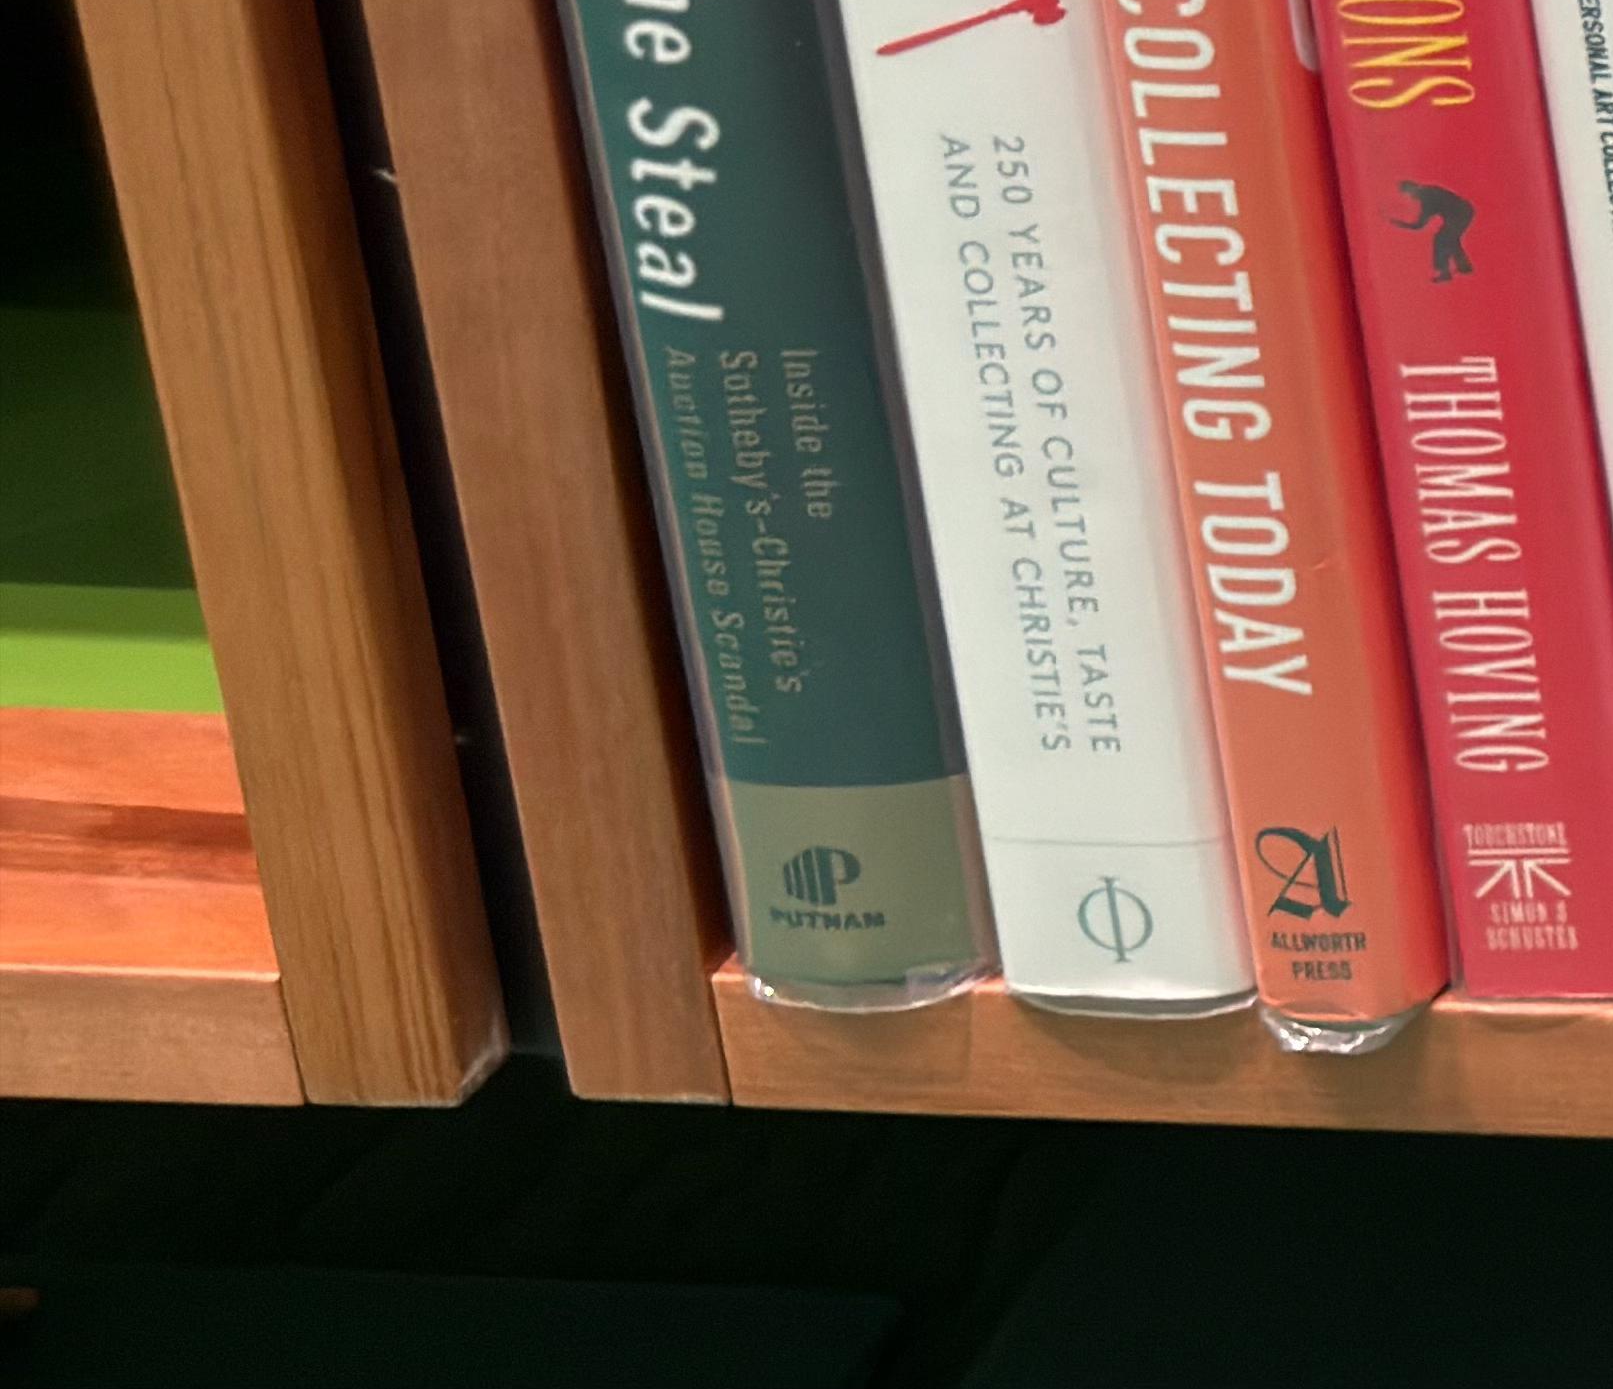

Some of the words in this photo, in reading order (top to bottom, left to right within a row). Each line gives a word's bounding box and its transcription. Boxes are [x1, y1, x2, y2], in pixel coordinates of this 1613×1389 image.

[627, 99, 724, 321] Steal
[1400, 355, 1521, 566] THOMAS
[1193, 471, 1313, 697] TODAY
[1433, 590, 1549, 775] HOVING
[1268, 930, 1368, 954] ALLWORTH
[1291, 960, 1353, 983] PRESS
